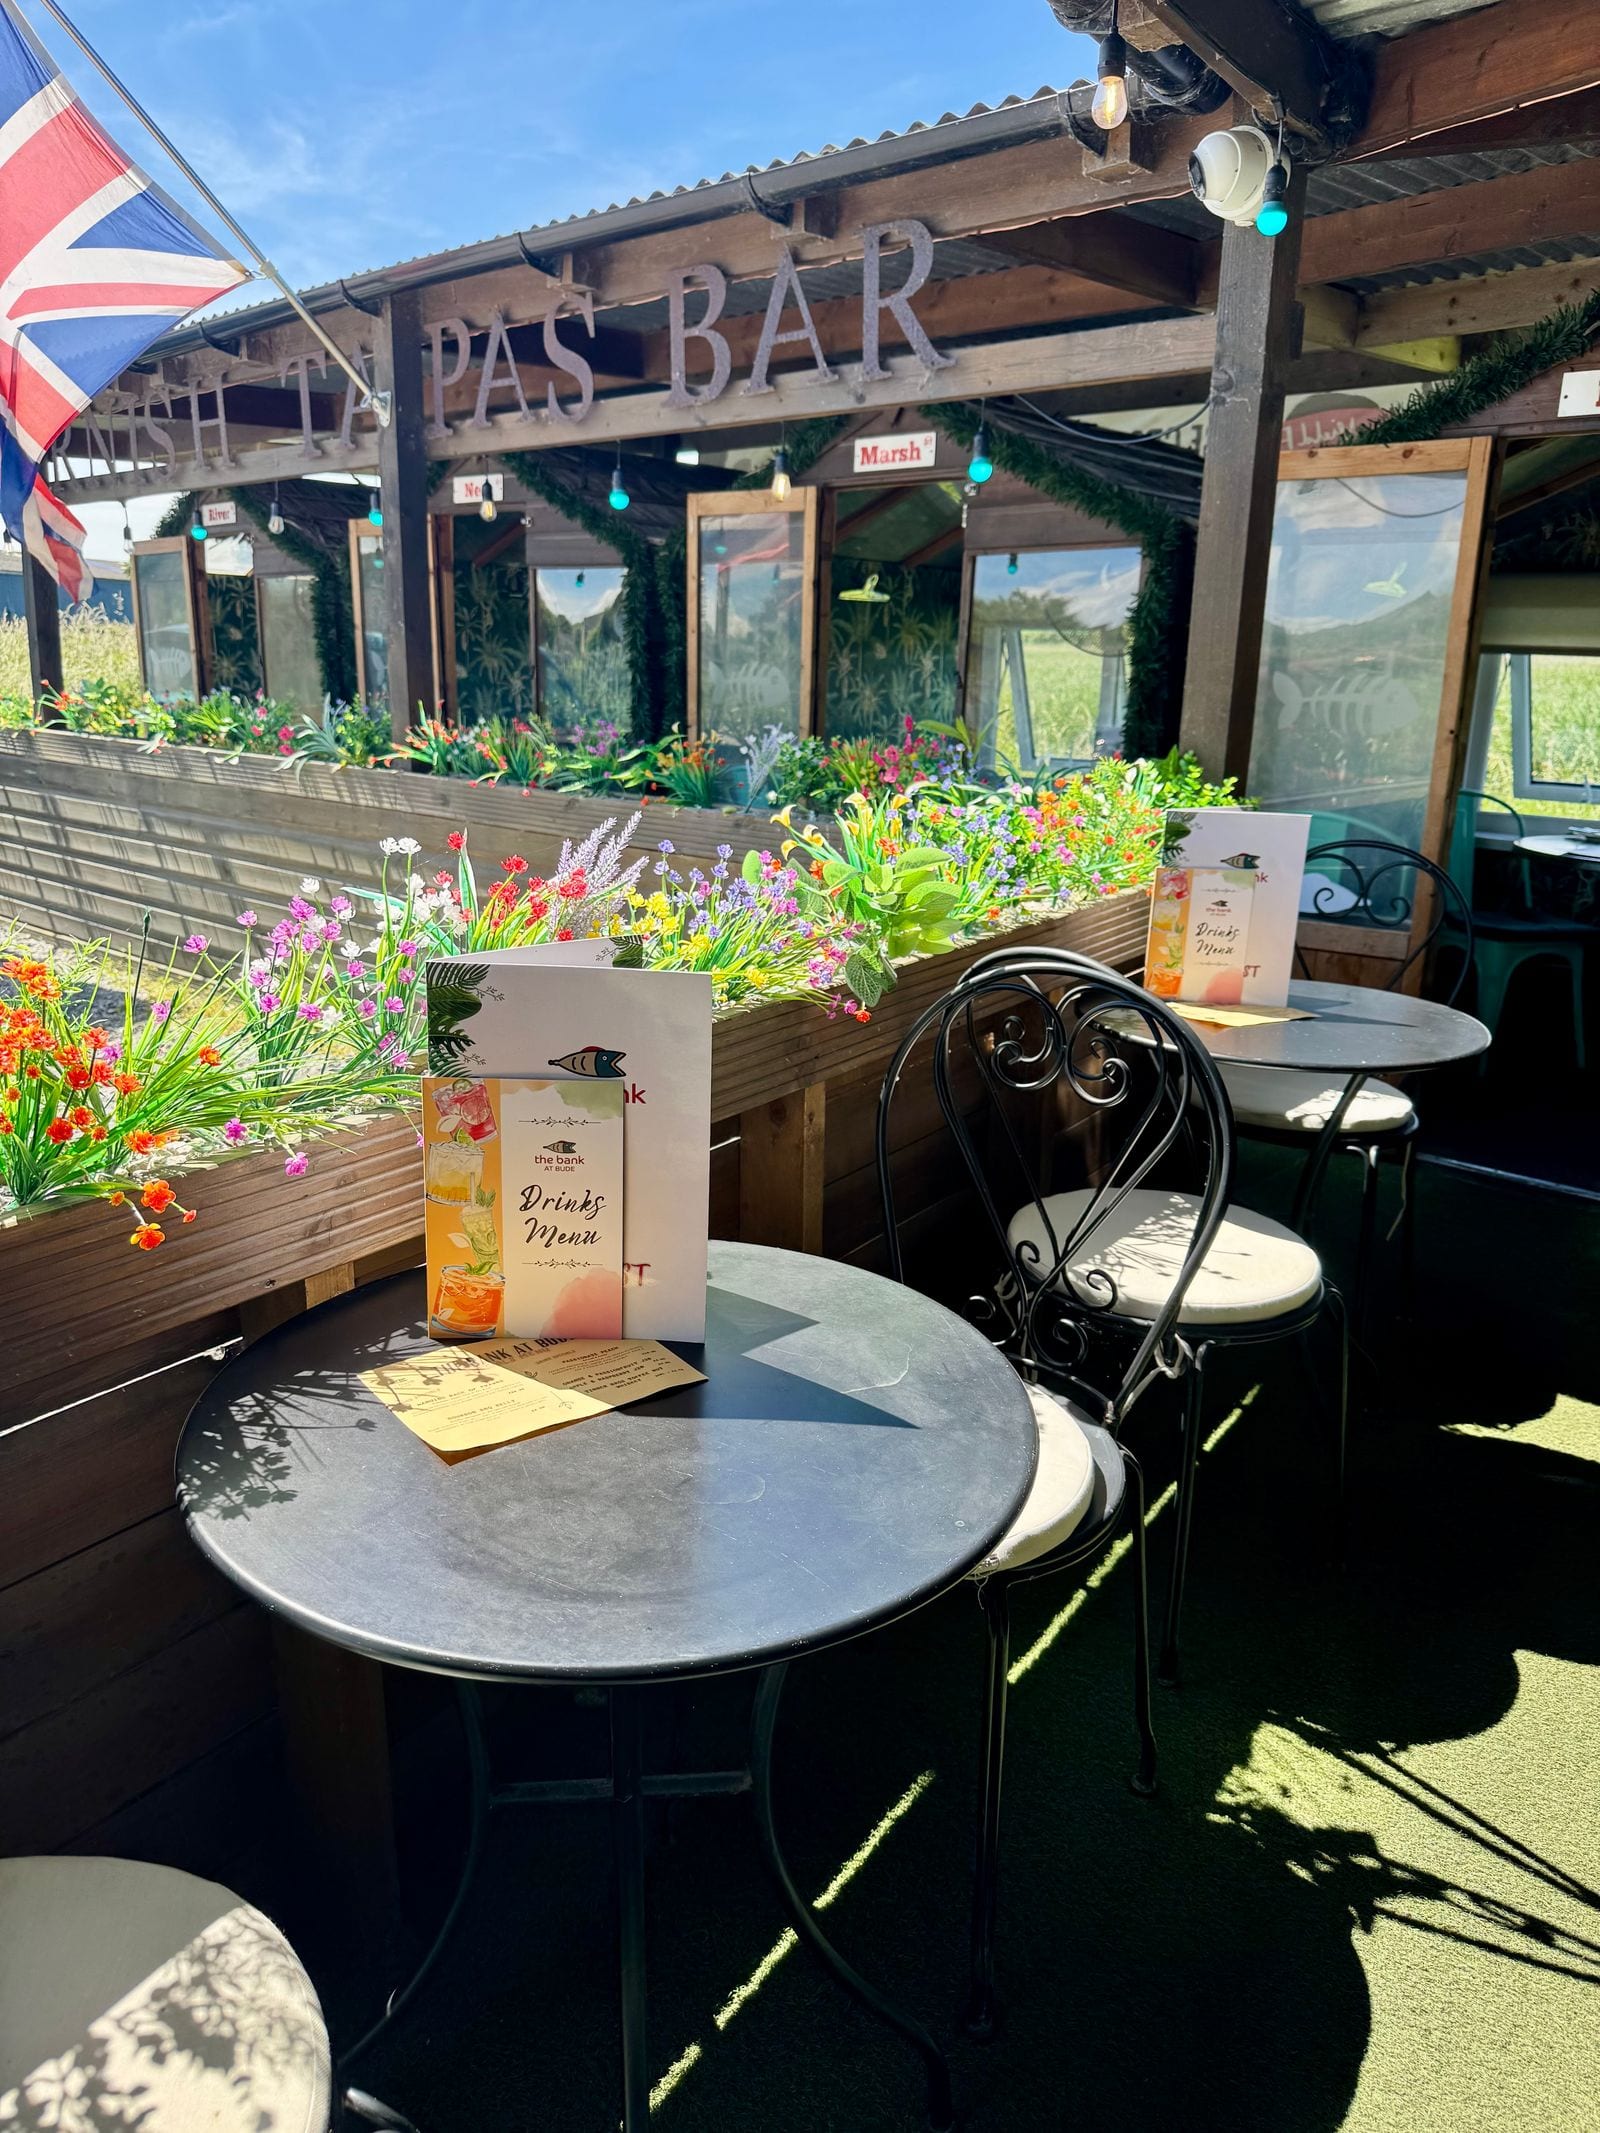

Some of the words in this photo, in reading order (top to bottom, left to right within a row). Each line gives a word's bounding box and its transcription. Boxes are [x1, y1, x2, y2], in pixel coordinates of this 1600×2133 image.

[280, 292, 597, 458] TAPAS
[660, 219, 956, 409] BAR
[860, 441, 921, 466] Marsh
[1195, 922, 1240, 942] Drinks
[1196, 939, 1235, 956] Menu
[534, 1155, 554, 1164] the
[556, 1155, 585, 1165] bank
[519, 1184, 607, 1221] Drinks
[524, 1217, 602, 1249] Menu
